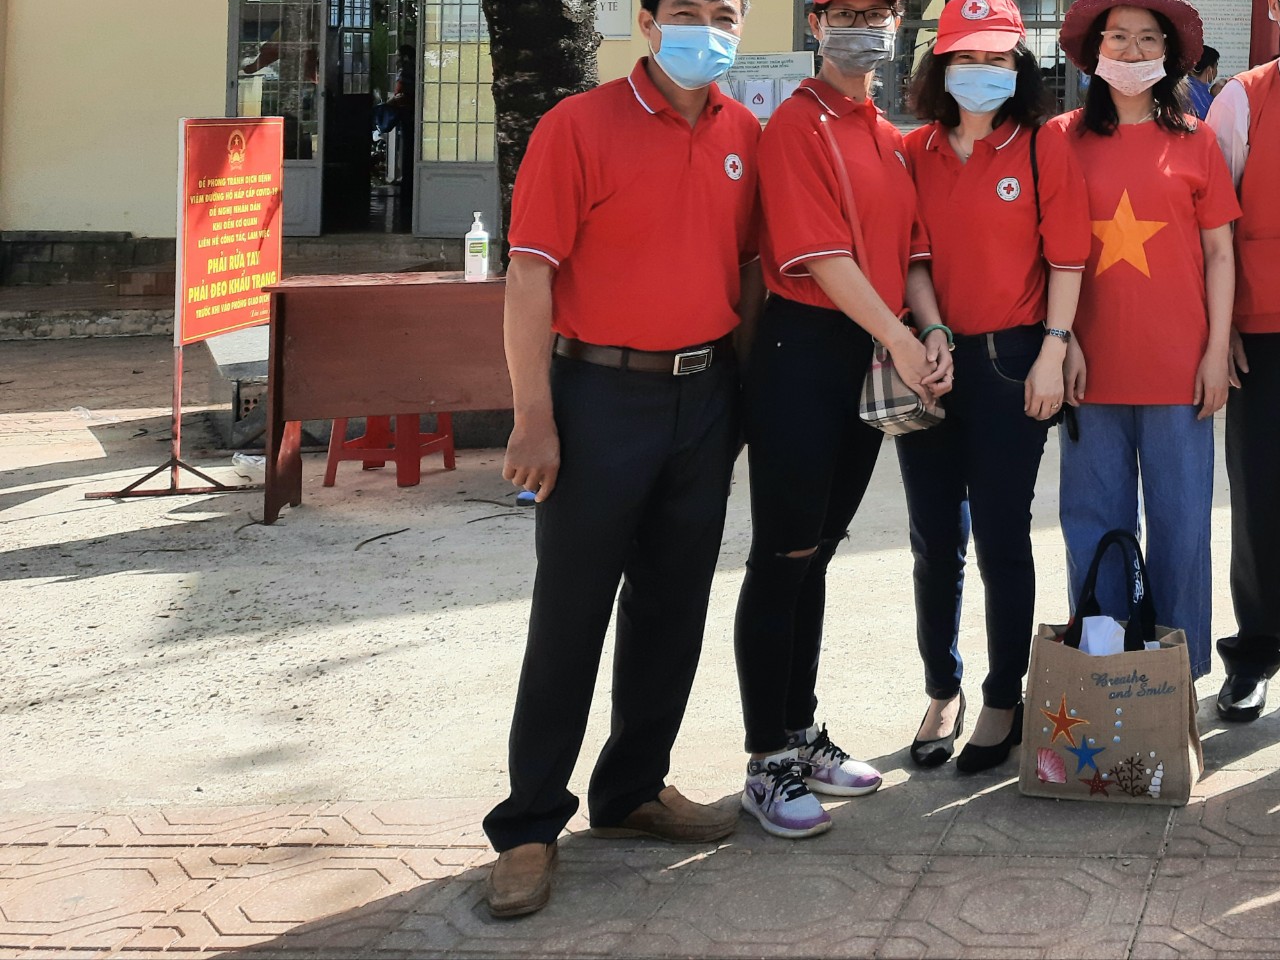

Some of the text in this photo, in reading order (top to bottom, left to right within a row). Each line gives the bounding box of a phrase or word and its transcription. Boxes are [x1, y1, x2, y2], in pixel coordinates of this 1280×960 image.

[207, 248, 260, 274] PHẢI RỬA TAY
[188, 270, 276, 303] PHẢI ĐEO KHẨU TRANG
[1091, 669, 1149, 687] Breathe
[1108, 681, 1176, 700] and Smile
